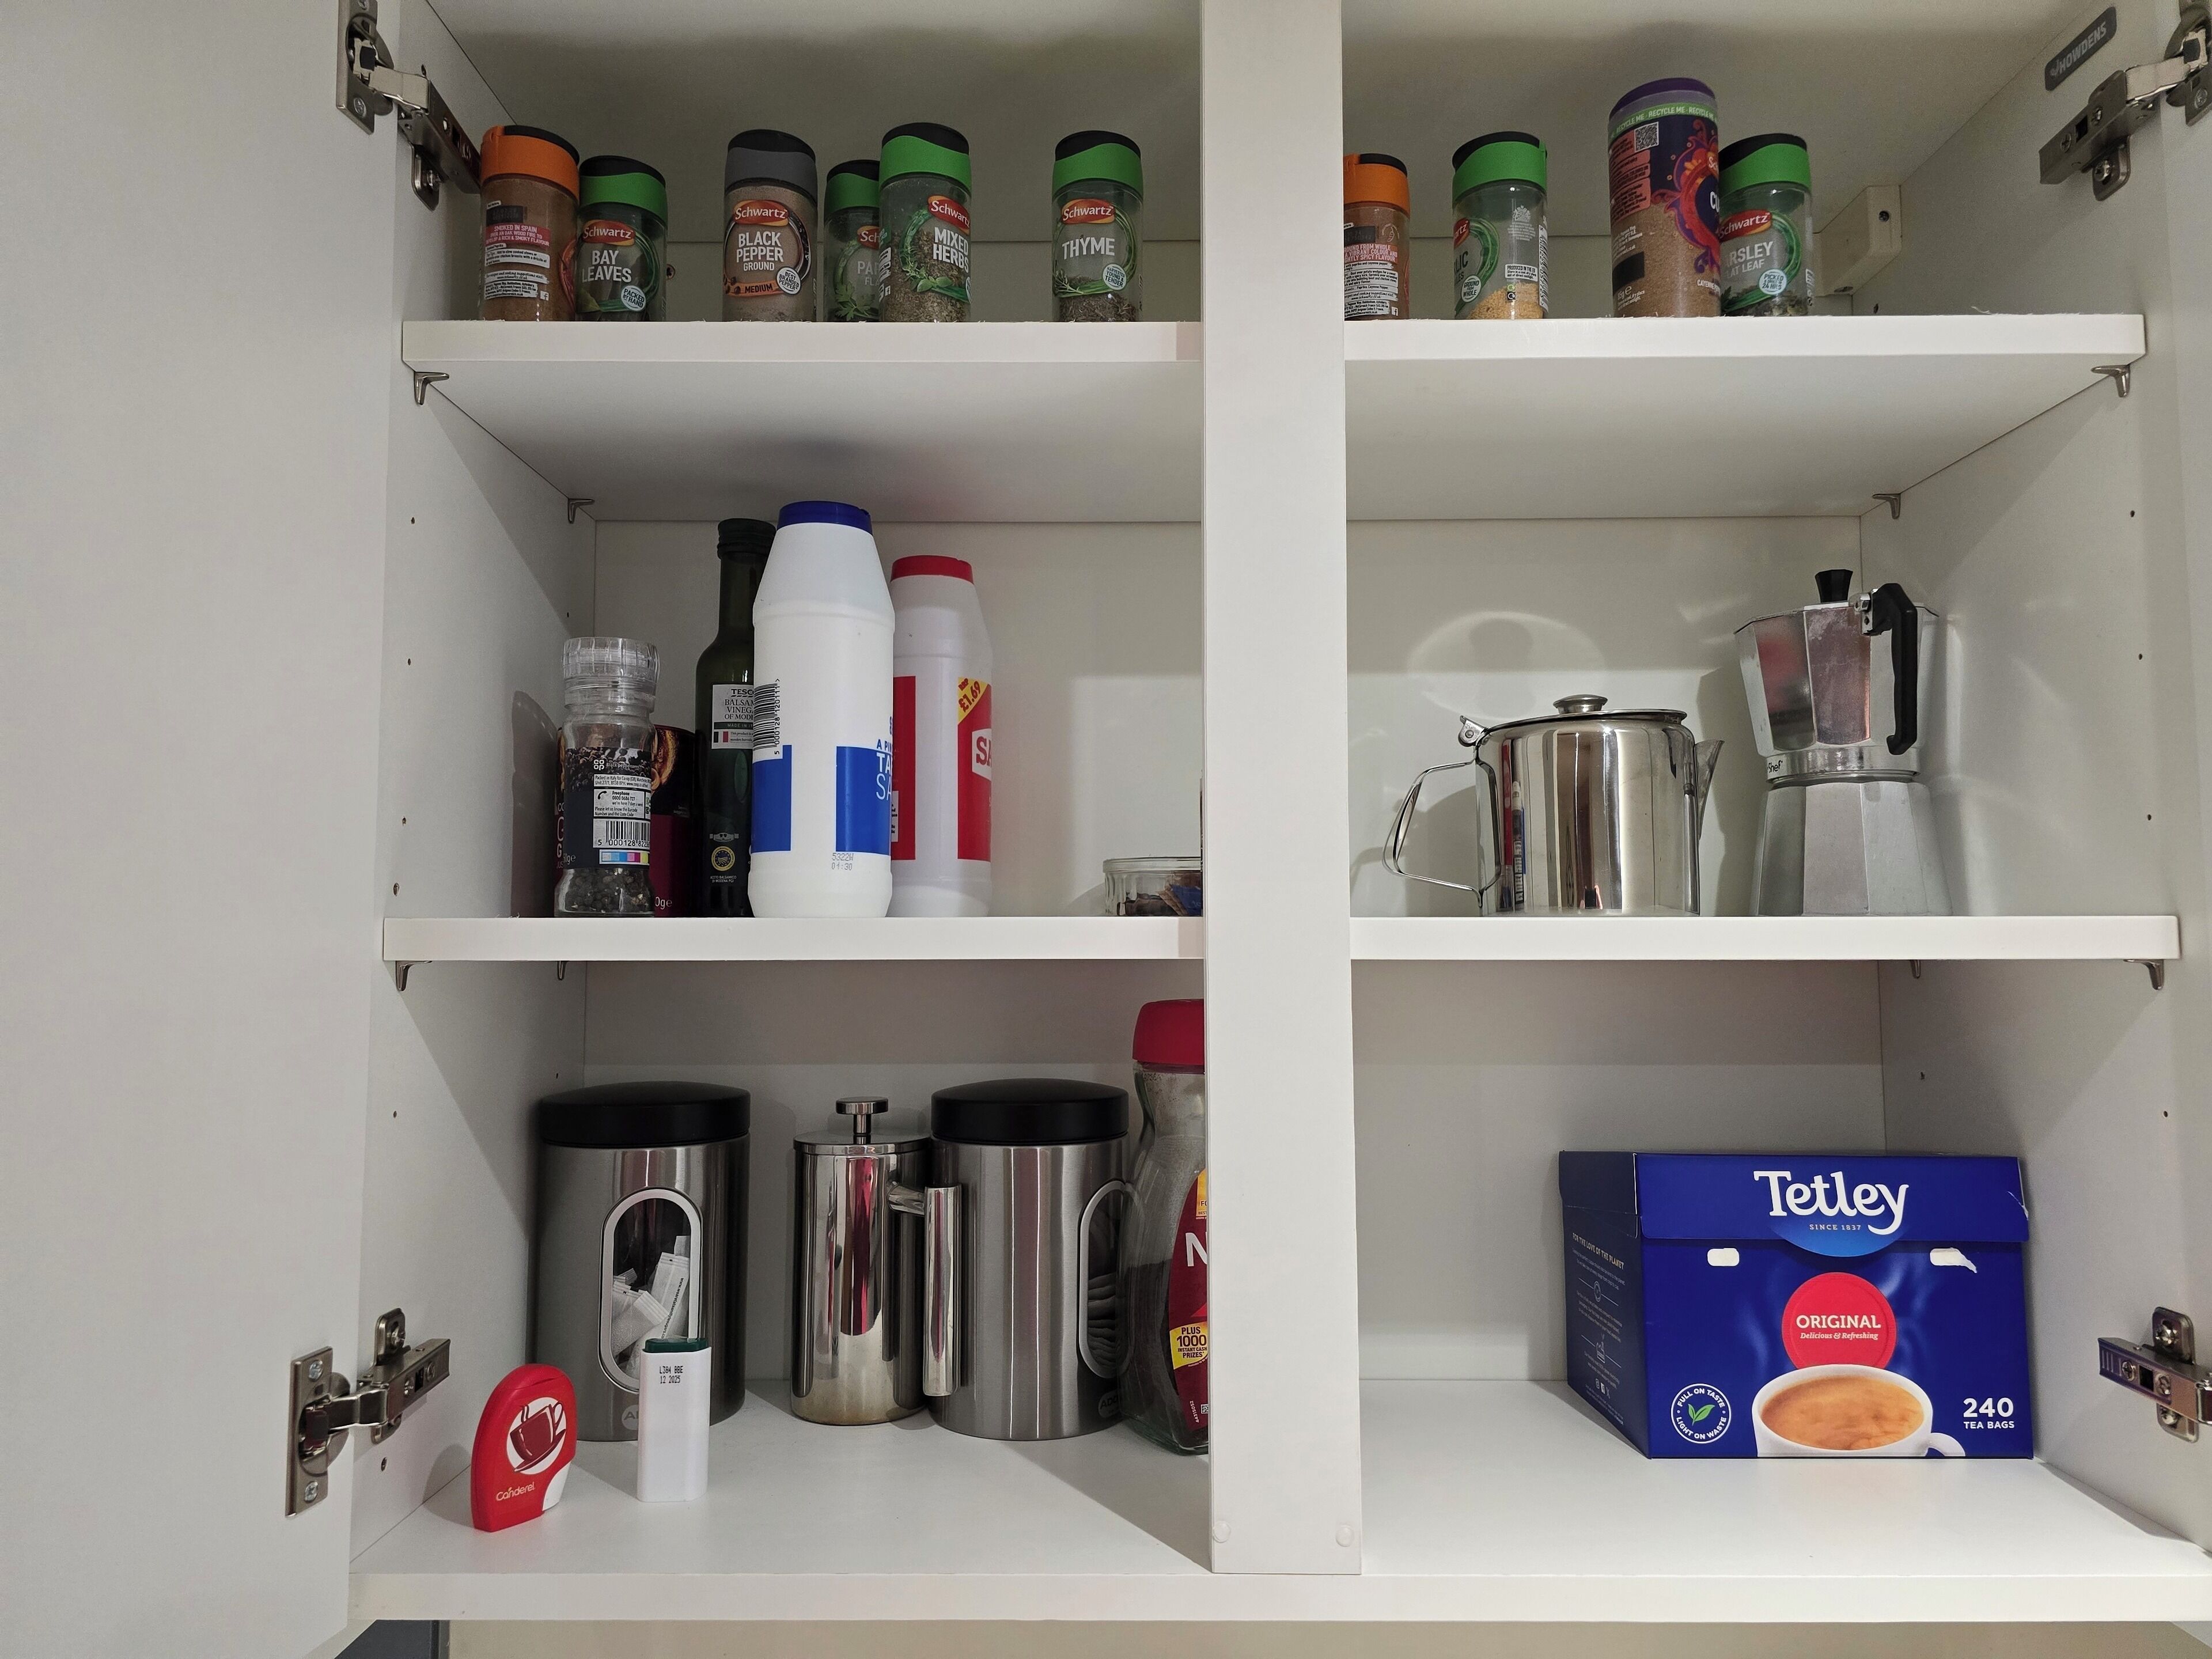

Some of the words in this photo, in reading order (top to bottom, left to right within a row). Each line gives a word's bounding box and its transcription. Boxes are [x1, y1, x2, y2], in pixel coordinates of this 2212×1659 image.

[2059, 21, 2107, 75] HOWDENS
[1616, 116, 1635, 133] RECYCLE
[1635, 113, 1645, 123] ME
[1649, 108, 1675, 118] RECYCLE
[1689, 107, 1710, 117] RECYCLE
[735, 206, 786, 220] Schwartz
[931, 200, 970, 228] Schwartz
[1063, 206, 1112, 221] Schwartz
[583, 226, 632, 239] Schwartz
[1718, 215, 1768, 238] Schwartz
[531, 237, 550, 247] FLAVOUR
[738, 231, 781, 248] BLACK
[934, 226, 968, 256] MIXED
[736, 247, 784, 263] PEPPER
[1062, 237, 1115, 260] THYME
[1729, 241, 1774, 265] RSLEY
[592, 249, 619, 265] BAY
[933, 243, 969, 274] HERBS
[1375, 254, 1396, 262] FLAVOUR
[743, 262, 775, 271] GROUND
[1741, 259, 1765, 272] LEAF
[582, 266, 632, 283] LEAVES
[779, 274, 800, 287] BRANDED
[785, 271, 796, 281] BEST
[1104, 275, 1123, 287] TENDER
[1106, 270, 1120, 279] YOUNG
[745, 283, 772, 293] MEDIUM
[1464, 280, 1479, 288] GROUND
[624, 289, 645, 302] PACKED
[628, 297, 644, 308] HAND
[958, 681, 981, 713] £1.69
[876, 738, 881, 750] A
[831, 862, 853, 870] 01:30
[1753, 1171, 1910, 1235] Tetley
[1586, 1241, 1595, 1253] LOVE
[1595, 1247, 1601, 1256] OF
[1609, 1255, 1624, 1270] PLANET
[1796, 1315, 1881, 1328] ORIGINAL
[1181, 1327, 1201, 1335] PLUS
[1841, 1332, 1878, 1340] Refreshing
[1177, 1334, 1207, 1347] 1000
[674, 1365, 684, 1374] BBE
[660, 1376, 666, 1384] 12
[669, 1375, 681, 1384] 2025
[1677, 1391, 1694, 1407] FULL
[1707, 1389, 1725, 1408] TASTE
[1963, 1397, 2014, 1418] 240
[1676, 1416, 1694, 1436] LIGHT
[1706, 1416, 1727, 1438] WASTE
[1963, 1421, 1984, 1429] TEA
[1987, 1421, 2014, 1429] BAGS
[495, 1481, 536, 1501] Canderel
